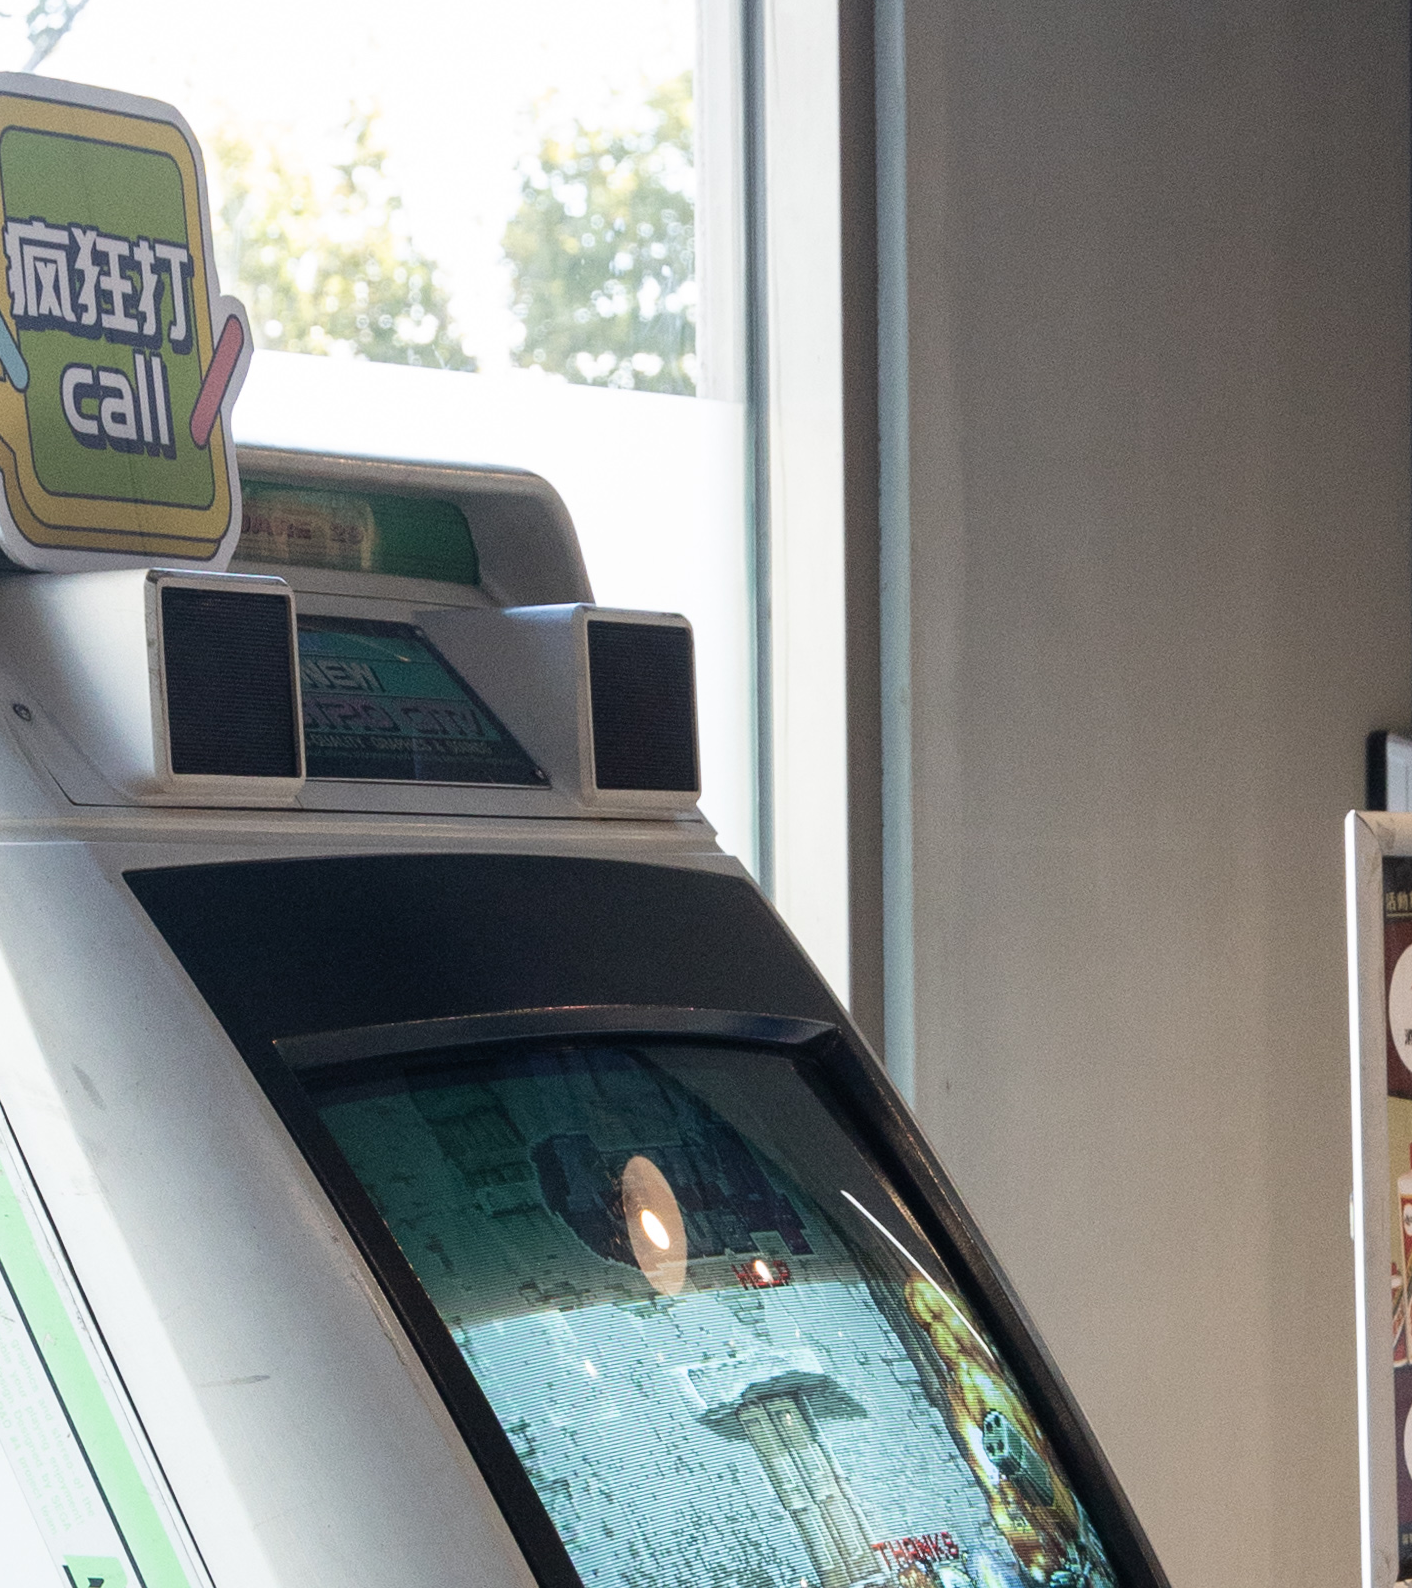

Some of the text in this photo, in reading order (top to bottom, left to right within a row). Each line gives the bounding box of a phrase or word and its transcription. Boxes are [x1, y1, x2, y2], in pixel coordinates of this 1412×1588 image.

[3, 219, 191, 344] 疯狂打
[60, 350, 174, 452] call
[871, 1530, 960, 1570] THANKS
